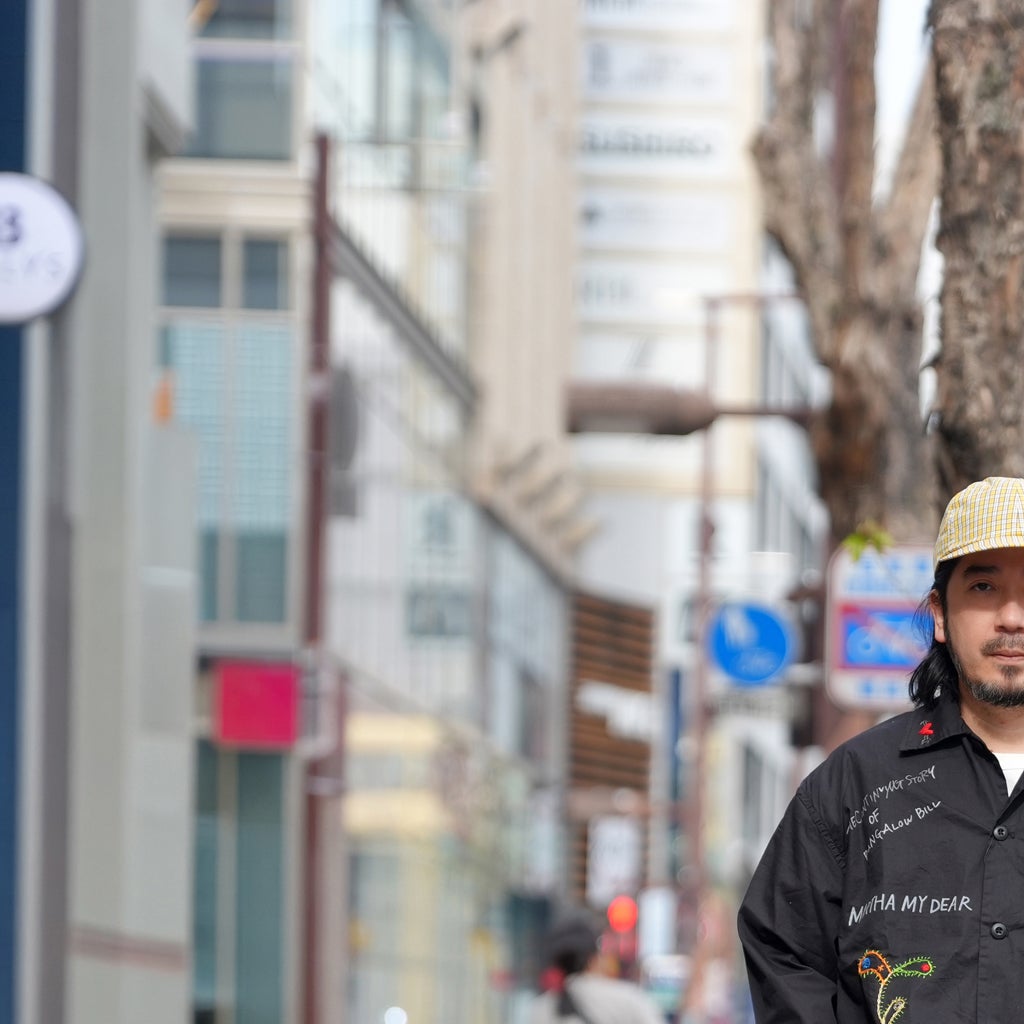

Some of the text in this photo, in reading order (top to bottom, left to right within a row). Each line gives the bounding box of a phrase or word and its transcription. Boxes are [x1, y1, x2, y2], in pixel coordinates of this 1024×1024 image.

[904, 765, 935, 786] STORY
[868, 808, 880, 824] OF
[863, 800, 941, 860] NGALOW BILL
[901, 895, 928, 914] MY
[930, 895, 973, 914] DEAR
